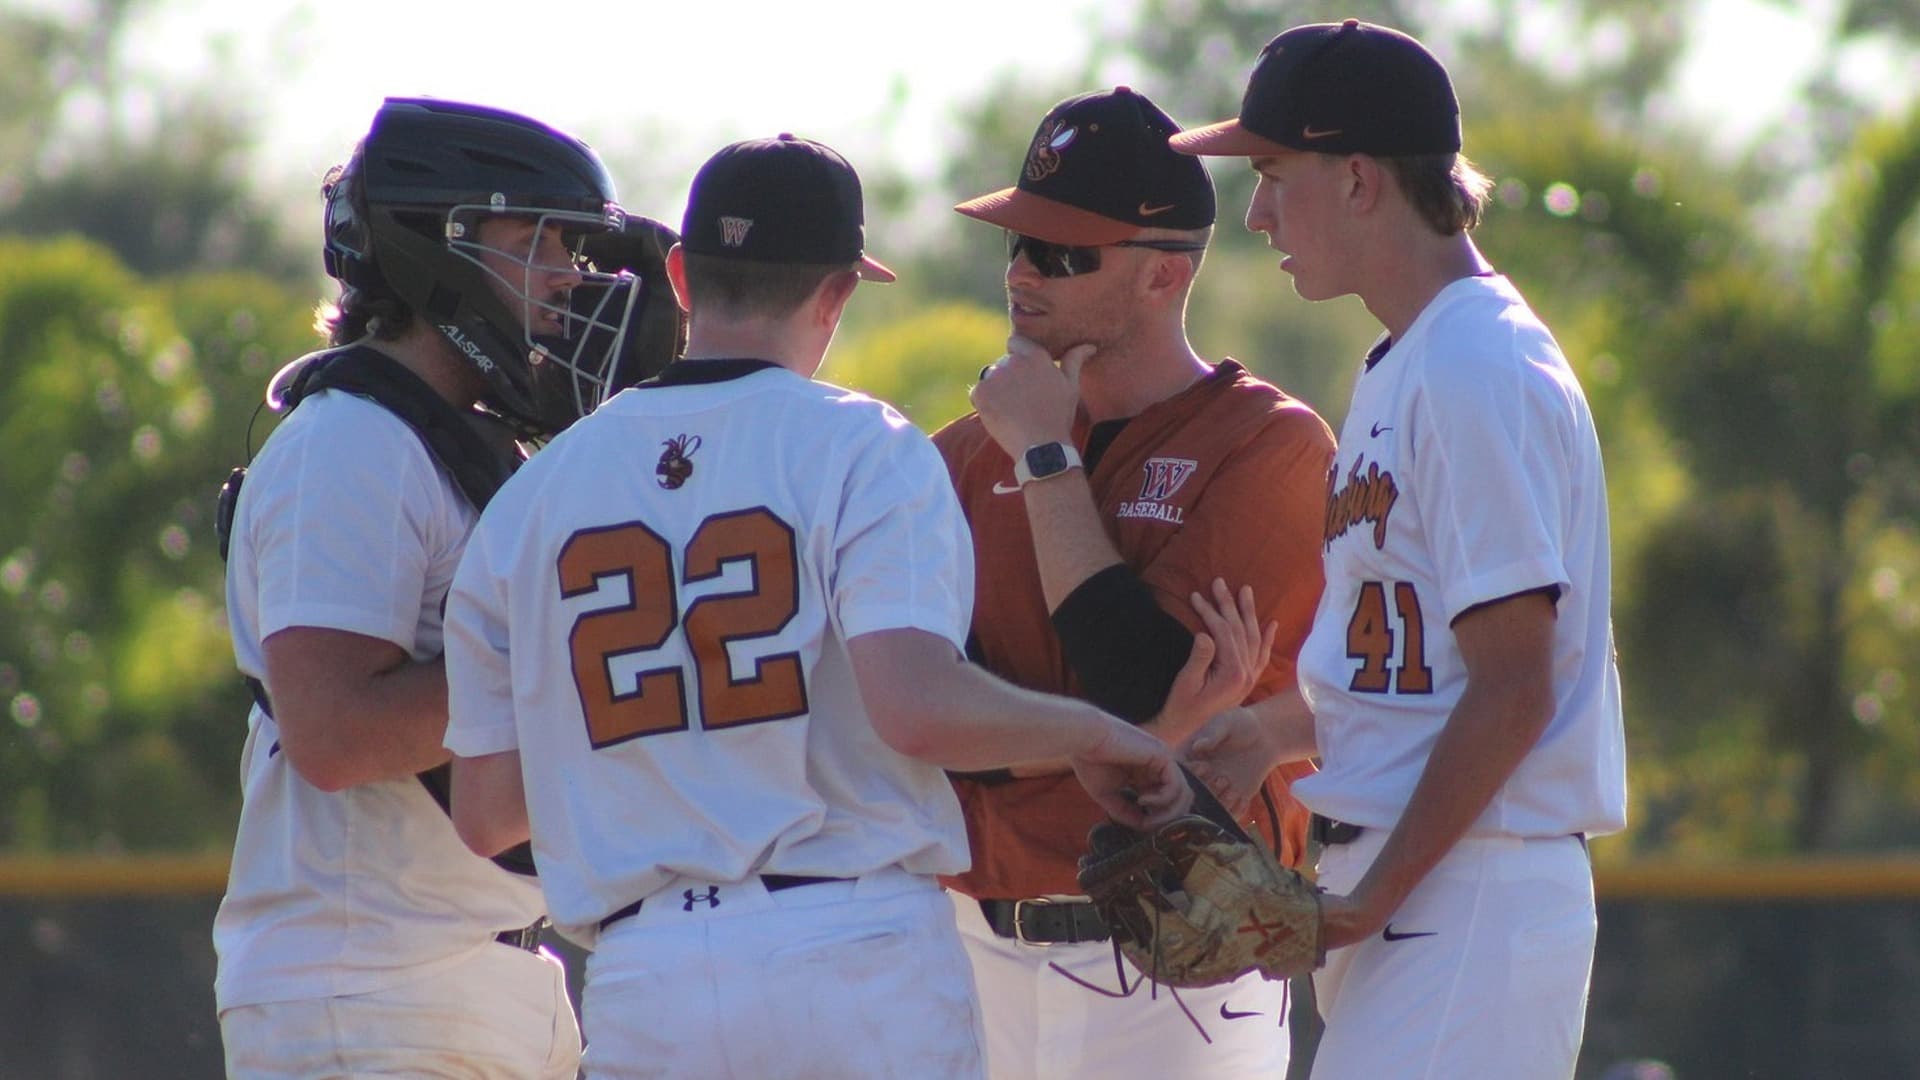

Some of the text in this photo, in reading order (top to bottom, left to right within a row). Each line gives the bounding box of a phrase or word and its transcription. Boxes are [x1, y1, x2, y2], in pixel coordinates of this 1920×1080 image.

[719, 216, 754, 248] W
[438, 324, 495, 373] ALL-STAR
[1138, 457, 1199, 501] W
[1117, 501, 1184, 525] BASEBALL
[556, 505, 810, 751] 22
[1346, 581, 1434, 695] 41
